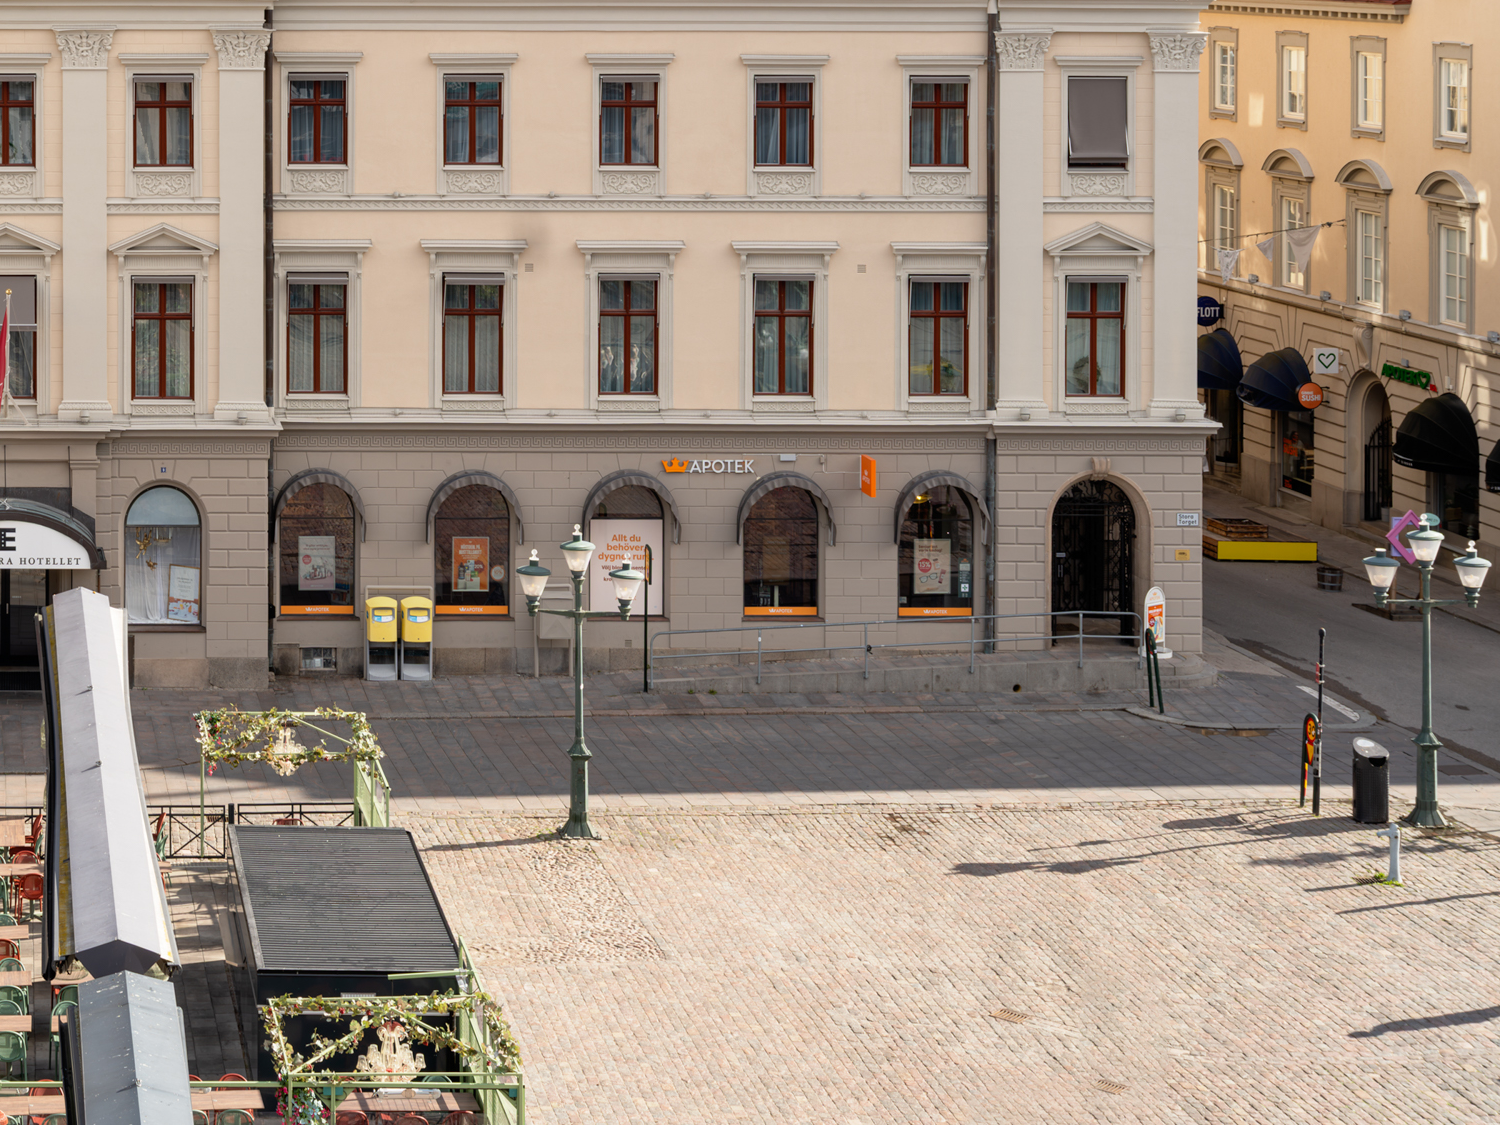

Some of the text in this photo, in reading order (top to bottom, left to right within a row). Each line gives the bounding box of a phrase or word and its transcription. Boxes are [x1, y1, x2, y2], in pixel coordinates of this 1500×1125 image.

[1381, 363, 1418, 386] APOTEK
[1301, 394, 1321, 402] SUSHI
[690, 459, 754, 474] APOTEK
[0, 527, 16, 551] E
[611, 534, 641, 542] Allt du
[606, 543, 646, 552] behöver,
[19, 557, 81, 566] HOTELLET
